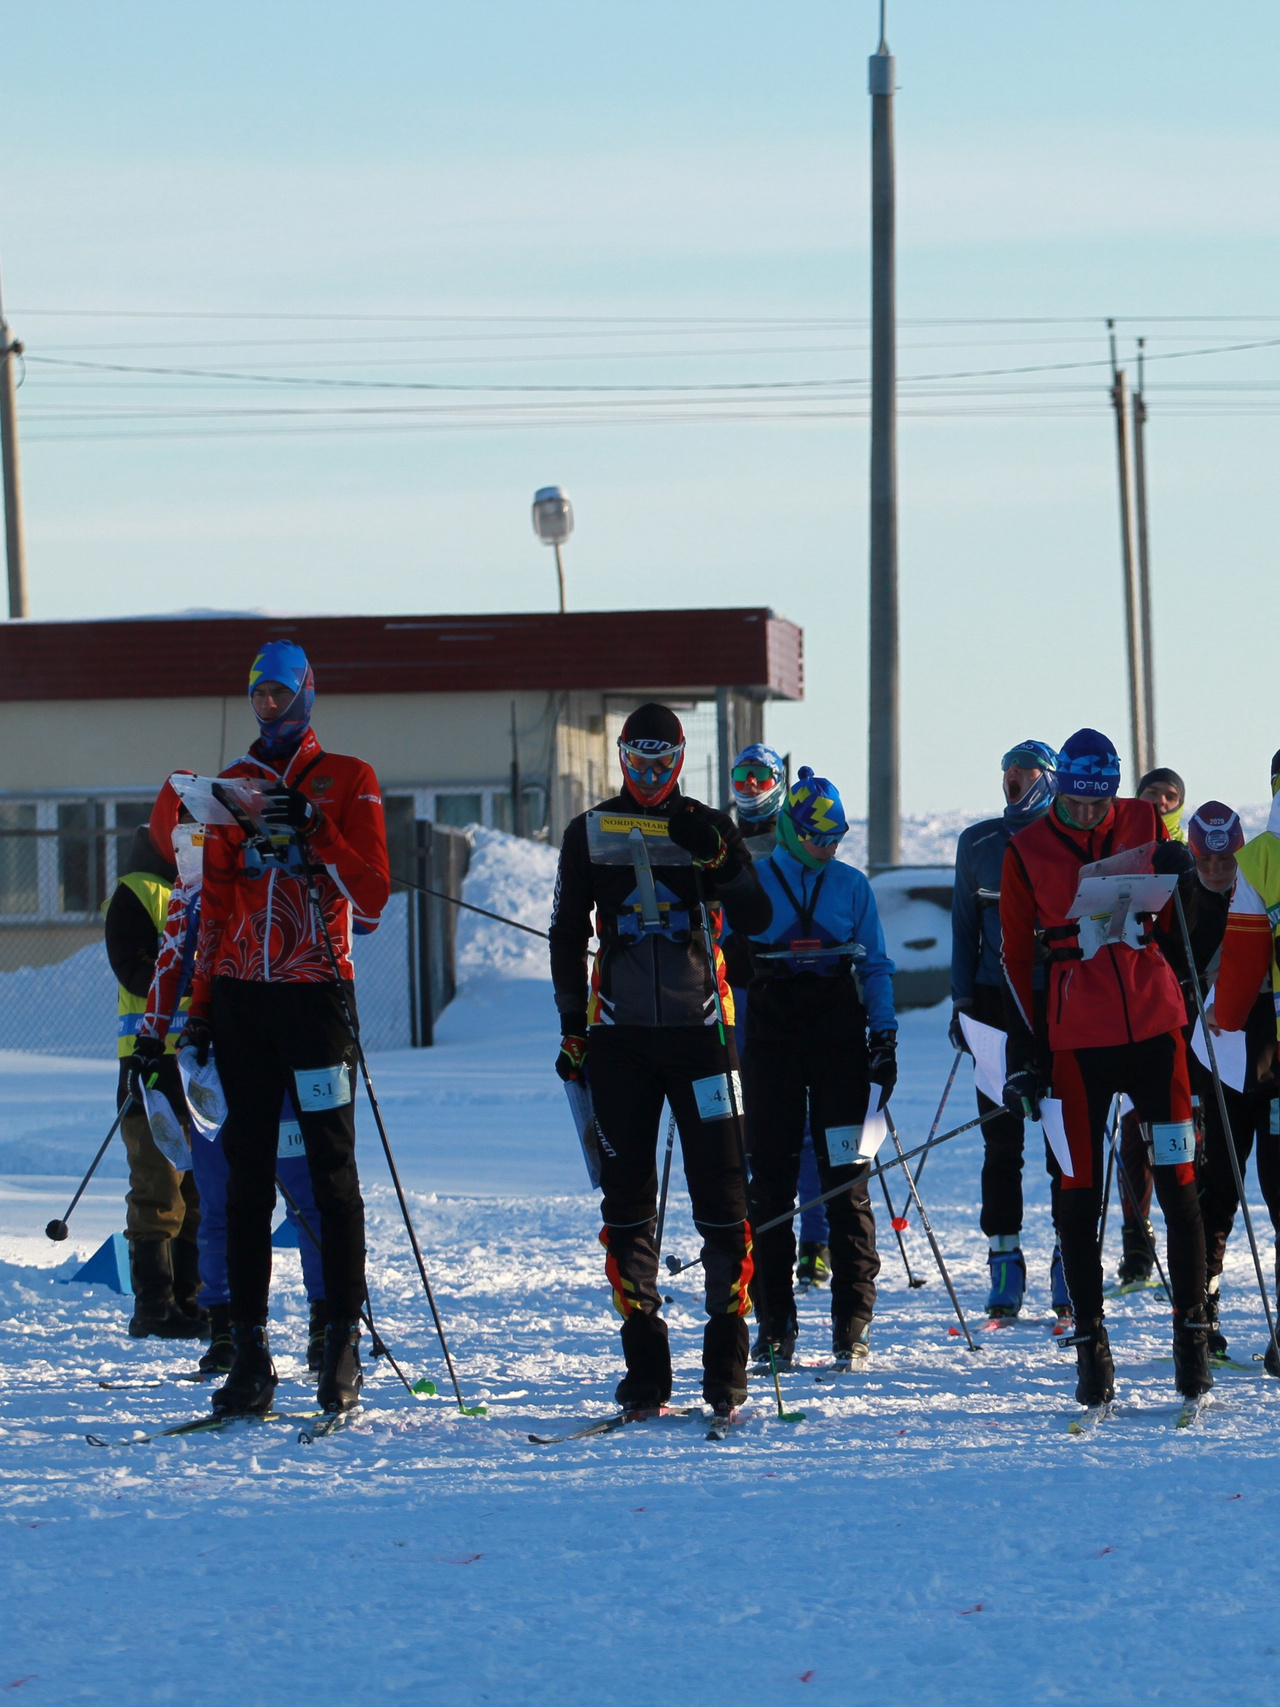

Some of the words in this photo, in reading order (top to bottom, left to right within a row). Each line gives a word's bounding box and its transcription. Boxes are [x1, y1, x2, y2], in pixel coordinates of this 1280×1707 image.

[312, 1082, 333, 1097] 5.1
[287, 1133, 303, 1146] 10
[1169, 1137, 1187, 1152] 3.1
